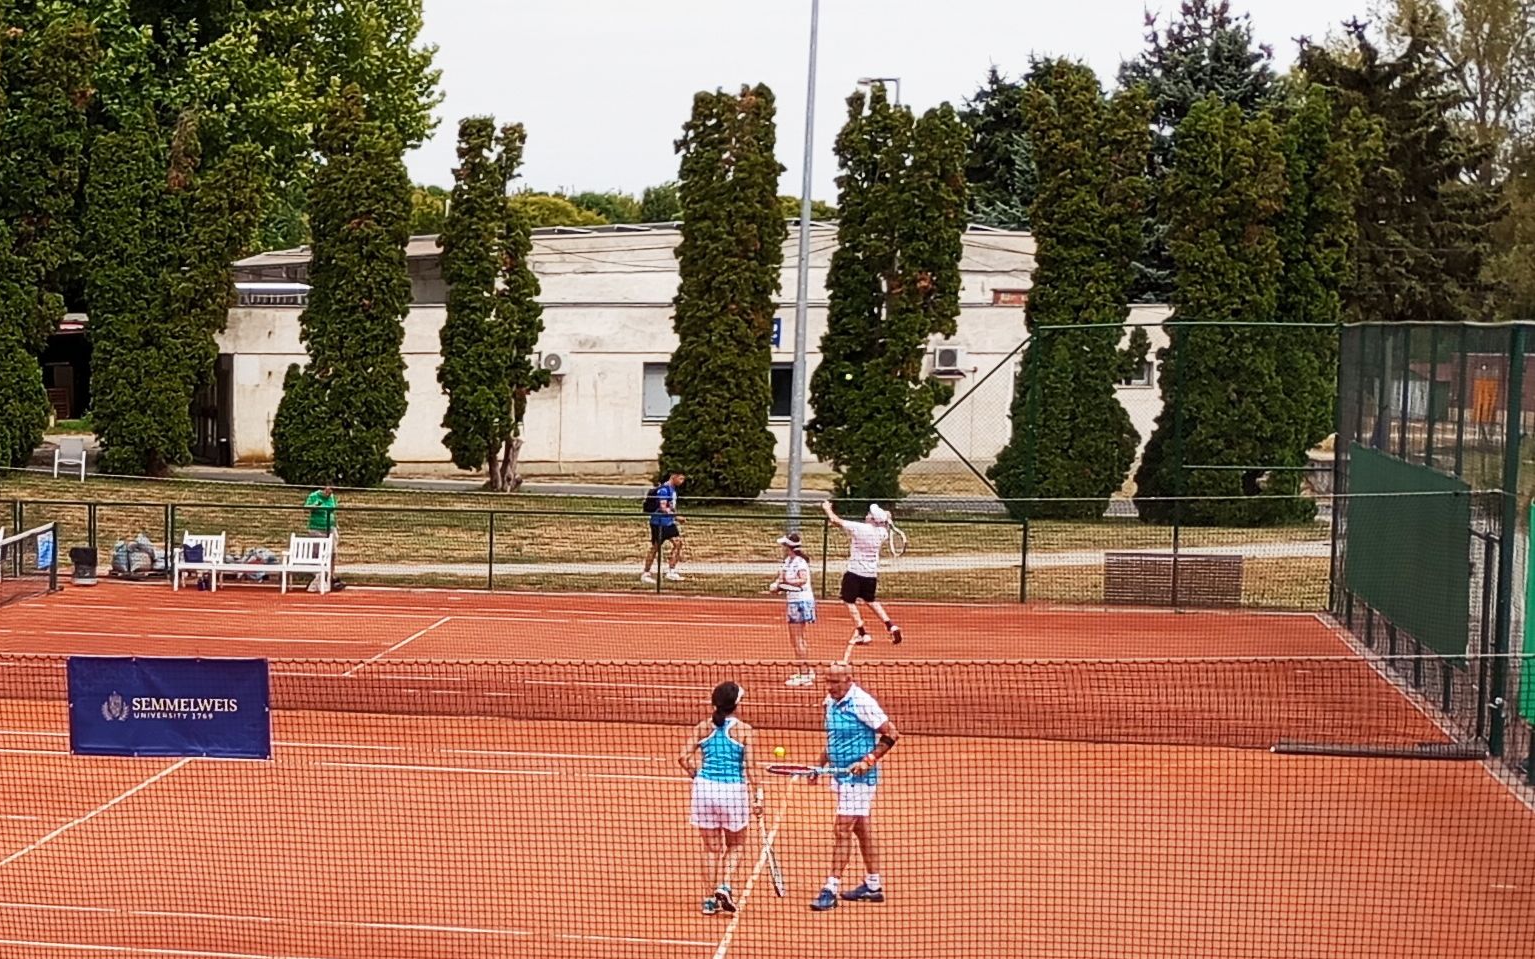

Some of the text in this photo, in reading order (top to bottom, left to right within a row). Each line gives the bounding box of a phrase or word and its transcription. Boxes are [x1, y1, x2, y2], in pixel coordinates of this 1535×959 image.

[132, 697, 238, 712] SEMMELWEIS
[133, 712, 214, 720] UNIVERSITY 1769
